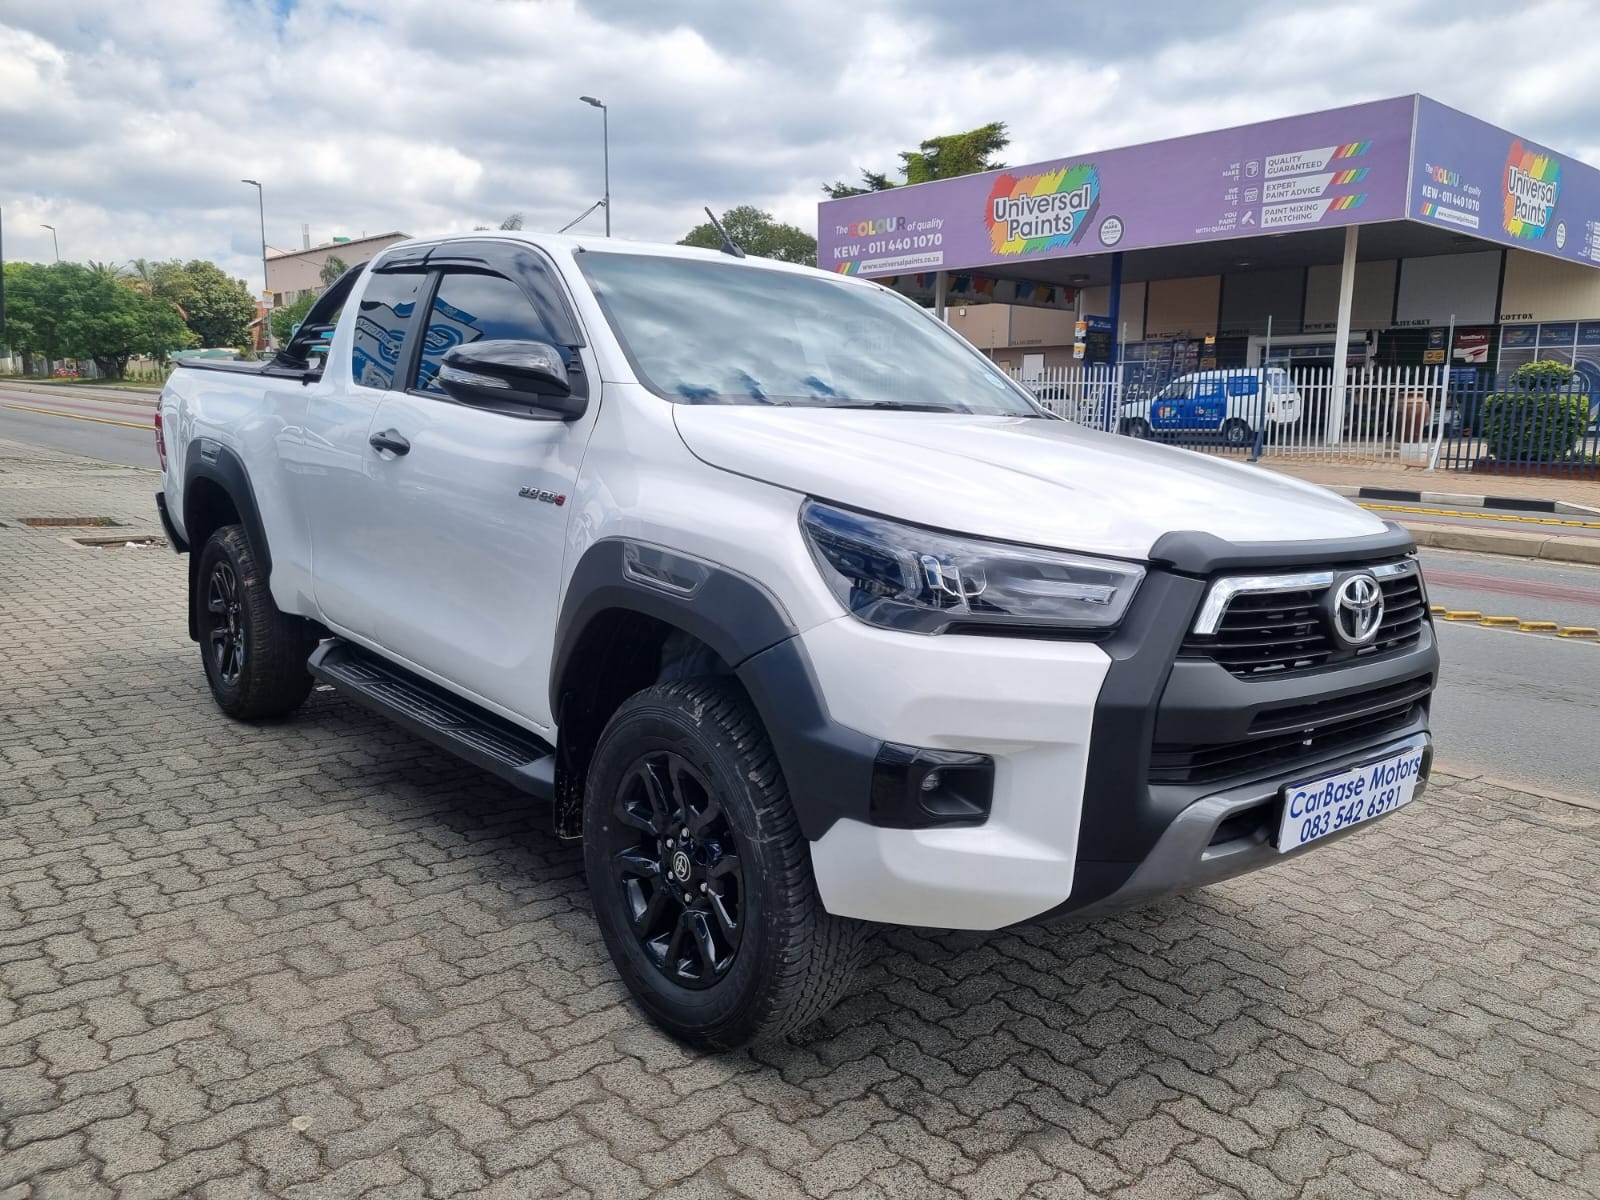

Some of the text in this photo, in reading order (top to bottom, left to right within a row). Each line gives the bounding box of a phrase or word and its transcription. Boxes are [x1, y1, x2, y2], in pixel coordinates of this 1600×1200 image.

[1267, 160, 1323, 175] GUARANTEED
[1268, 155, 1302, 167] QUALITY
[1222, 169, 1240, 177] MAKE
[1265, 186, 1321, 200] PAINT ADVICE
[1266, 181, 1297, 192] EXPERT
[1509, 167, 1556, 204] Universal
[995, 186, 1088, 220] Universal
[1422, 184, 1439, 200] KEW
[1442, 191, 1453, 204] 011
[1453, 194, 1465, 207] 440
[1465, 198, 1480, 212] 1070
[1264, 204, 1319, 217] PAINT MIXING
[1270, 213, 1313, 224] MATCHING
[1514, 197, 1546, 225] Paints
[836, 216, 944, 238] The COLOUR of quality
[1009, 213, 1072, 239] Paints
[1211, 223, 1236, 233] QUALITY
[834, 244, 860, 259] KEW
[868, 240, 886, 254] 011
[888, 237, 911, 252] 440
[913, 233, 943, 249] 1070
[862, 256, 940, 271] www.universalpaints.co.za
[1290, 756, 1421, 819] CarBase Motors
[1300, 786, 1401, 843] 083 542 6591
